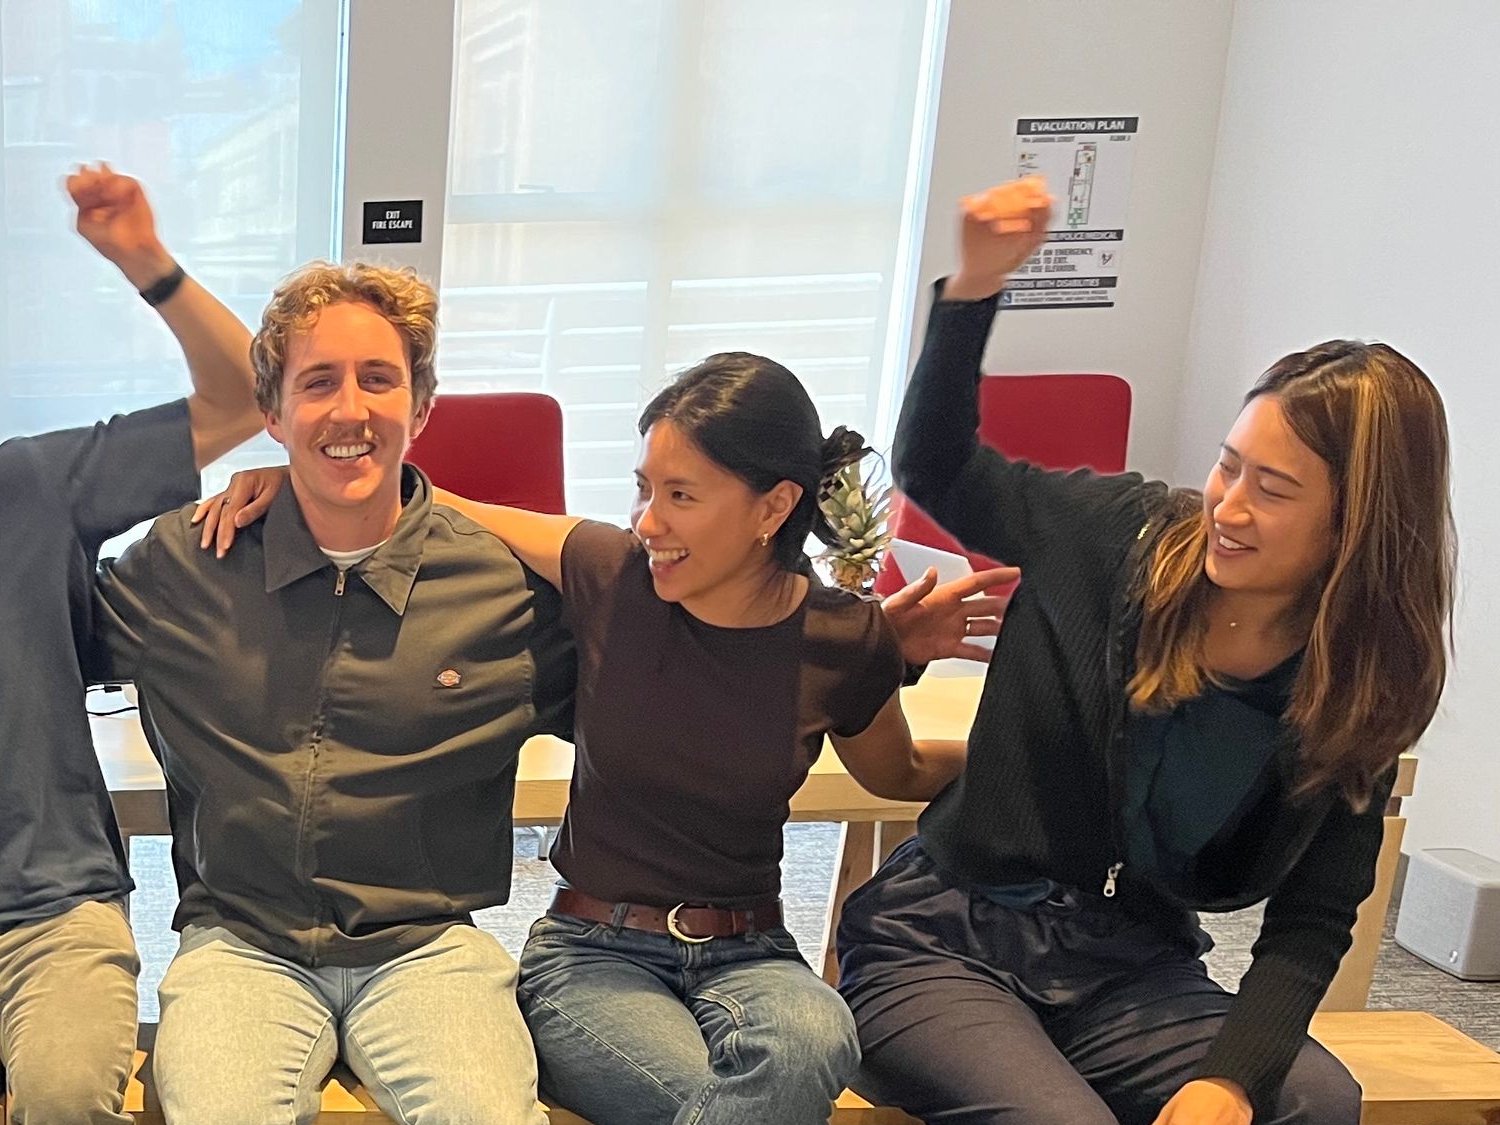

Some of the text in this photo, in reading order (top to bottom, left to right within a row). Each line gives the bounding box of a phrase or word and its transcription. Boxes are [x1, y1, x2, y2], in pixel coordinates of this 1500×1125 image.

[1030, 120, 1126, 132] EVACUATION PLAN
[386, 210, 400, 219] EXIT
[372, 219, 413, 229] FIRE ESCAPE
